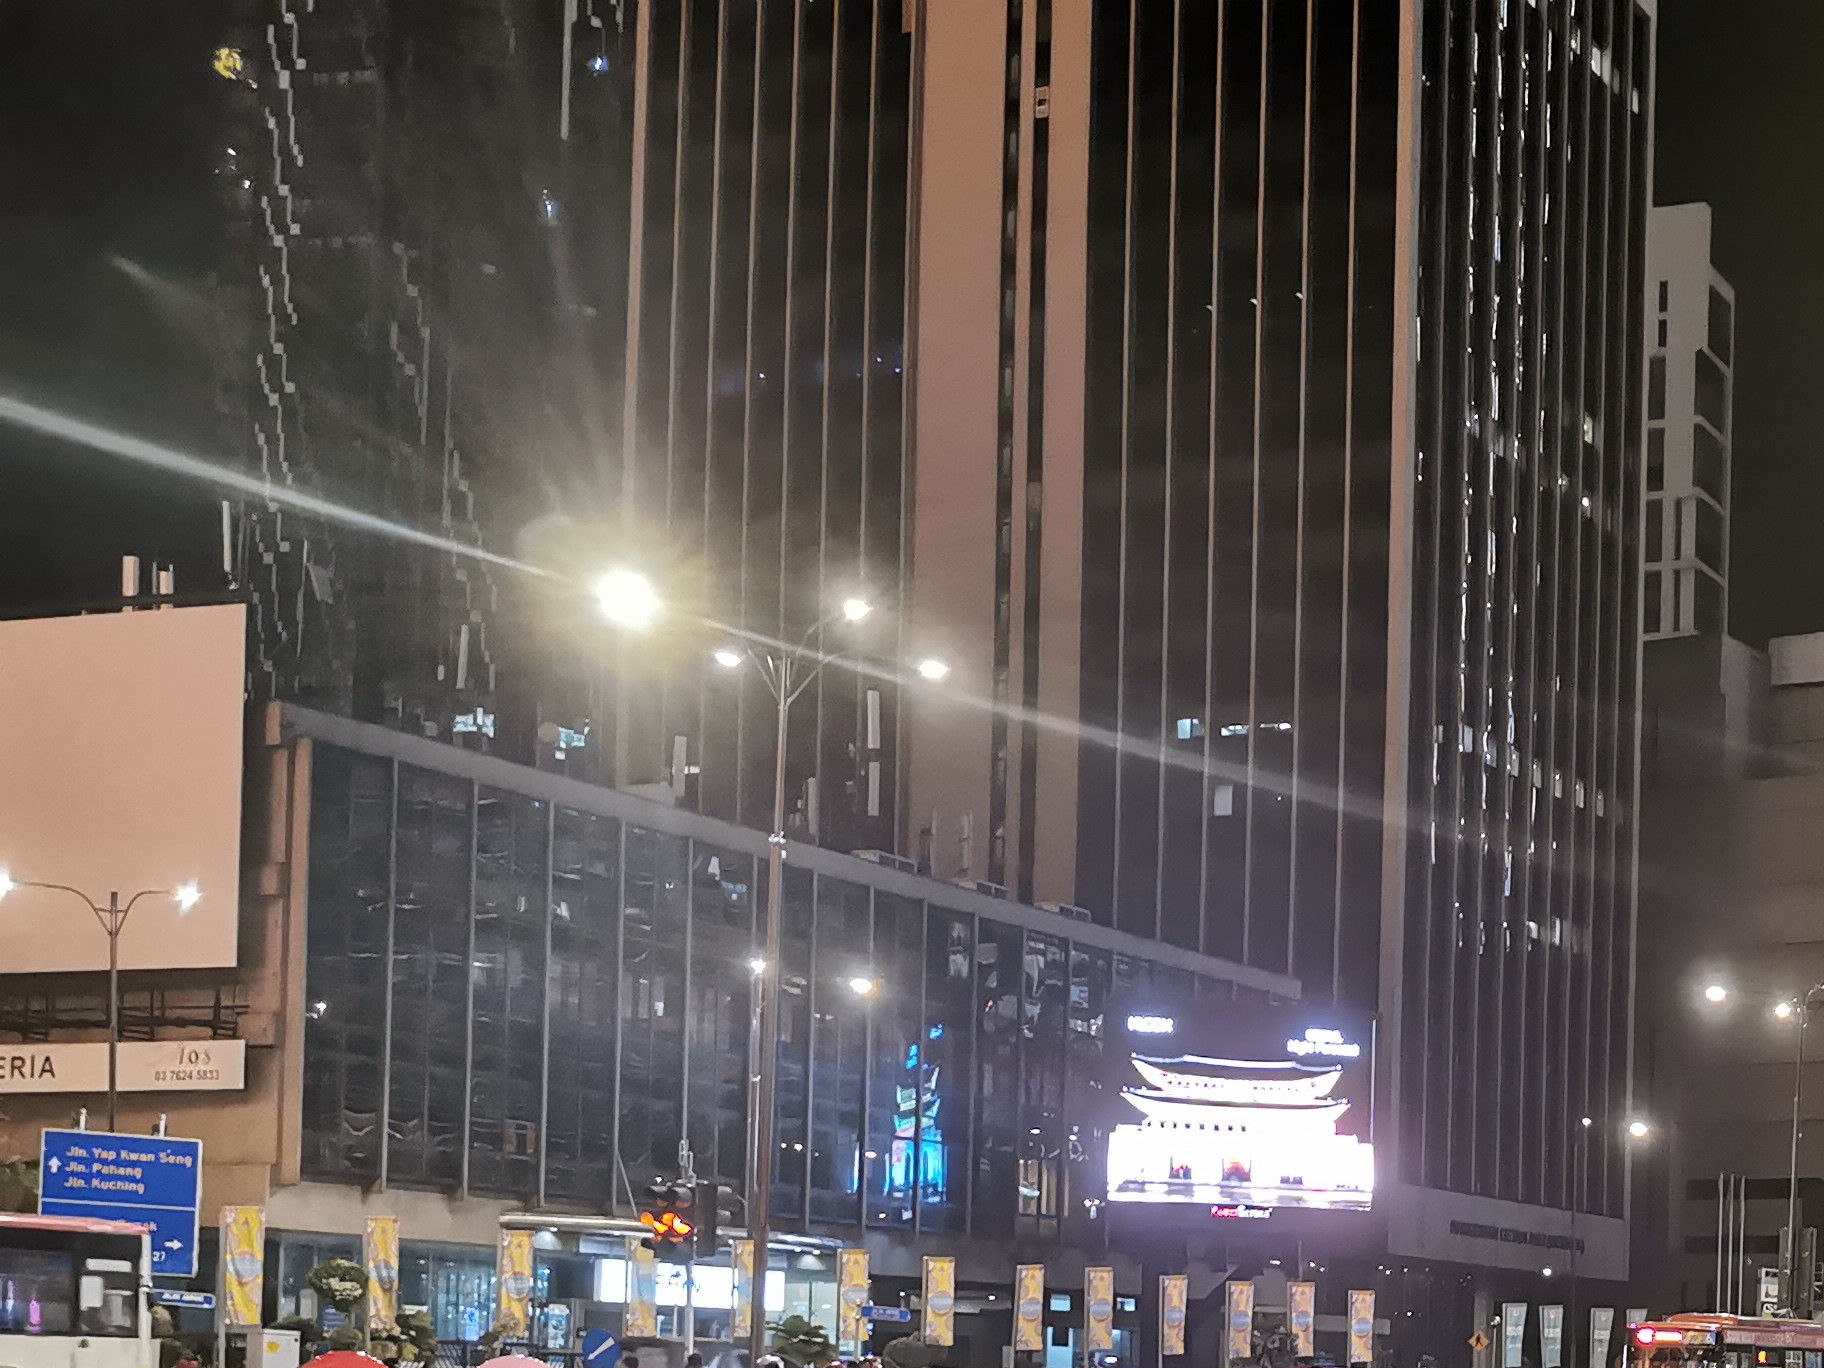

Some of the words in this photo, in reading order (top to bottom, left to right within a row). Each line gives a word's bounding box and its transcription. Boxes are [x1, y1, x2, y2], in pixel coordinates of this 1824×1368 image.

[92, 1147, 117, 1161] Yap
[120, 1149, 155, 1162] Kwan
[159, 1151, 193, 1168] Seng
[92, 1162, 143, 1179] Pahang
[92, 1178, 145, 1194] Kuching
